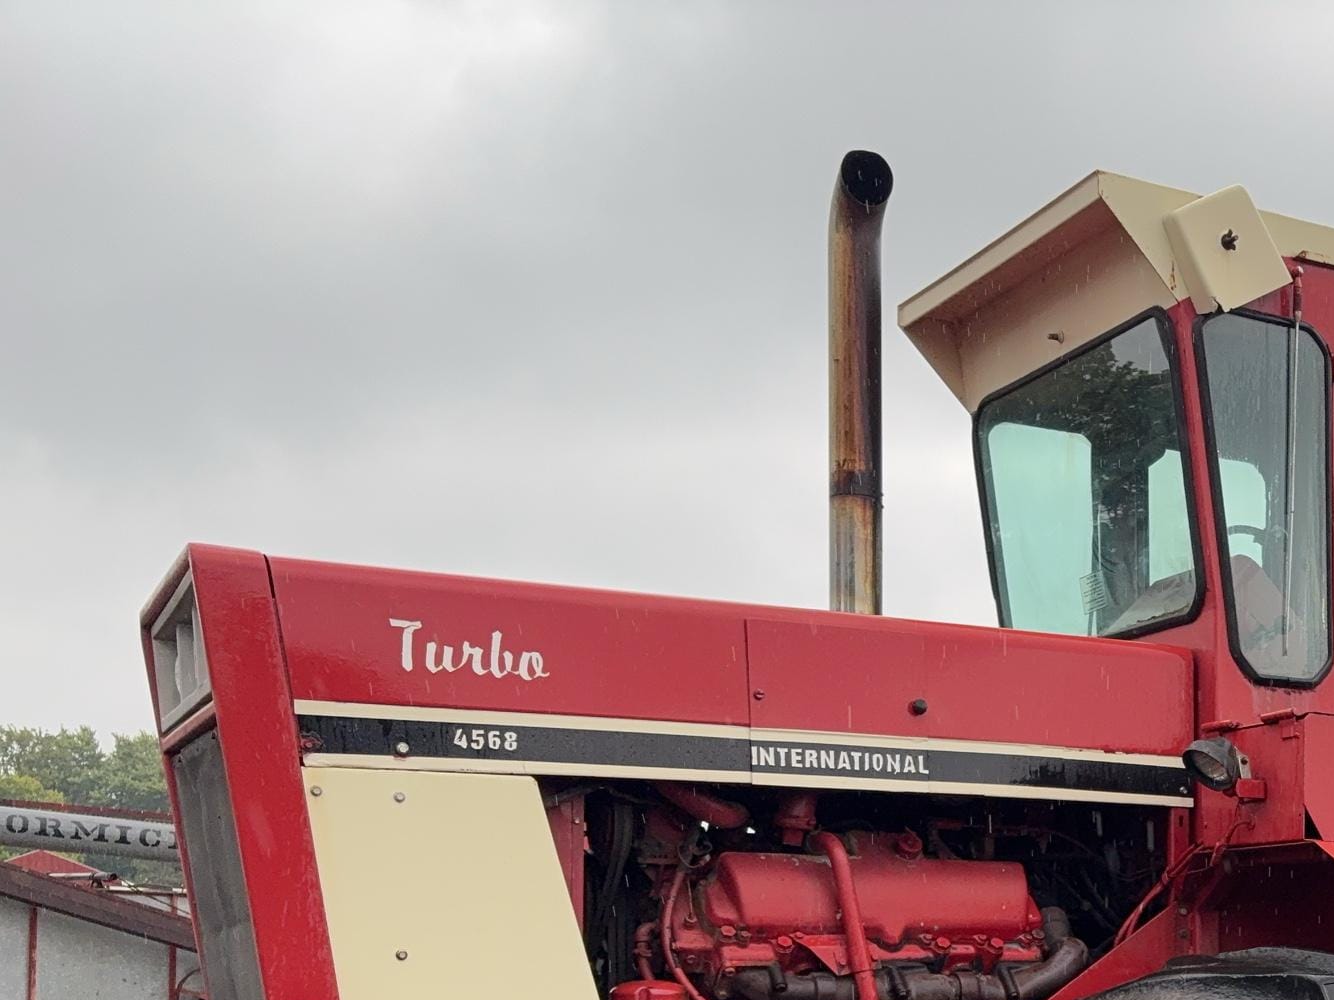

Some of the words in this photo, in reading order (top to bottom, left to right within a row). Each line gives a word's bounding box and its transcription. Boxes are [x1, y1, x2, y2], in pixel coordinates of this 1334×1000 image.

[389, 617, 551, 681] Turbo
[453, 728, 518, 751] 4568
[751, 745, 929, 775] INTERNATIONAL
[5, 813, 179, 850] ORMIC
